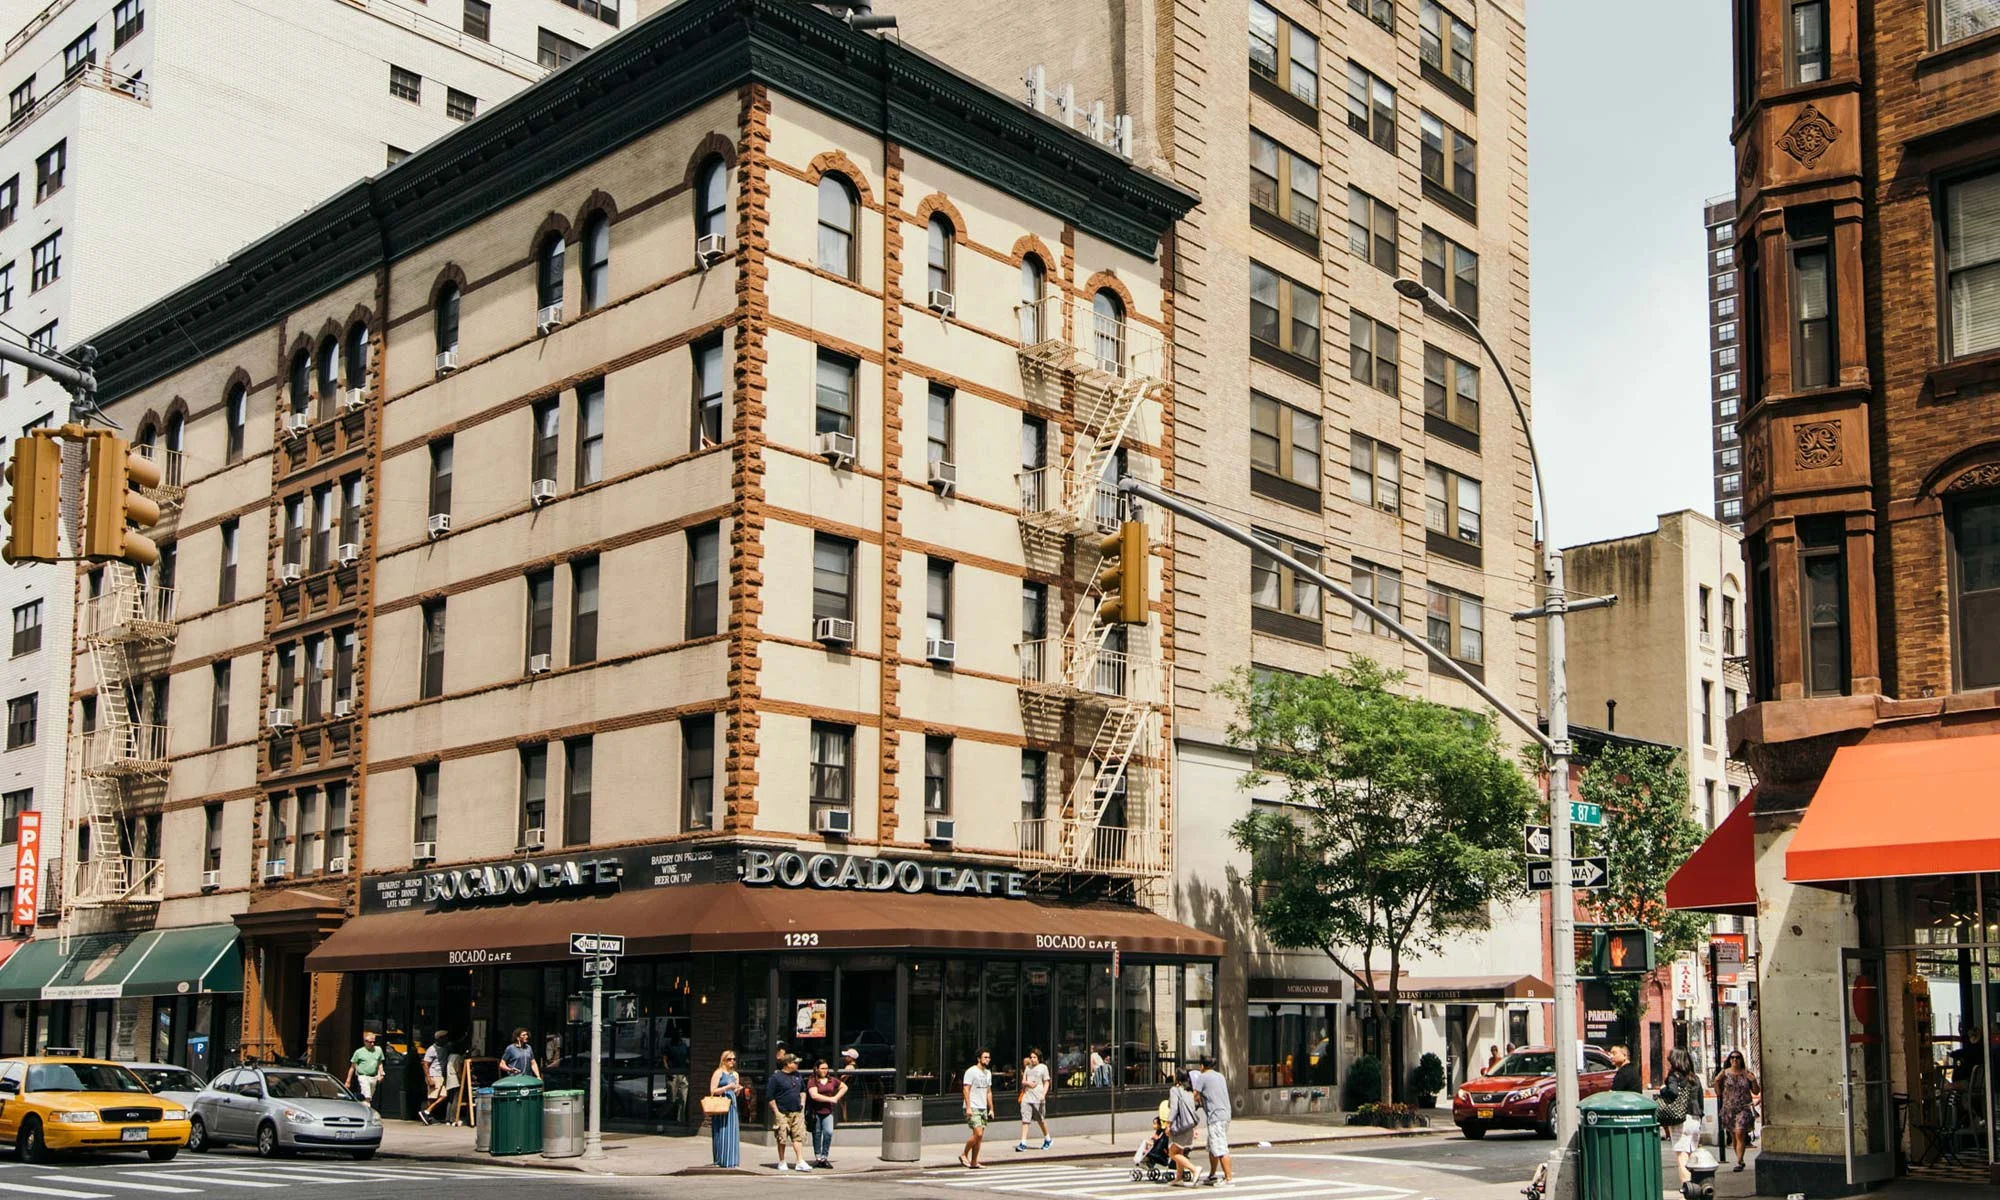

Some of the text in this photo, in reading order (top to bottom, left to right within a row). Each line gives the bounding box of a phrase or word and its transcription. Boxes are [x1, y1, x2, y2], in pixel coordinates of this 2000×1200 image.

[1578, 804, 1589, 821] 87
[1533, 834, 1548, 848] ONE
[651, 854, 674, 866] BAKERY
[674, 853, 684, 863] ON
[17, 829, 37, 905] PARK
[661, 864, 677, 874] WINE
[743, 849, 1027, 896] BOCADO CAFE
[1539, 866, 1595, 882] ON WAY
[423, 857, 619, 902] BOCADO CAFE
[654, 872, 692, 886] BEER ON TAP
[386, 899, 397, 908] LATE
[579, 940, 617, 950] ONE WAY
[784, 933, 819, 947] 1293
[1036, 934, 1118, 950] BOCADO CAFE
[449, 949, 512, 964] BOCADO CAFE
[197, 1043, 204, 1053] P
